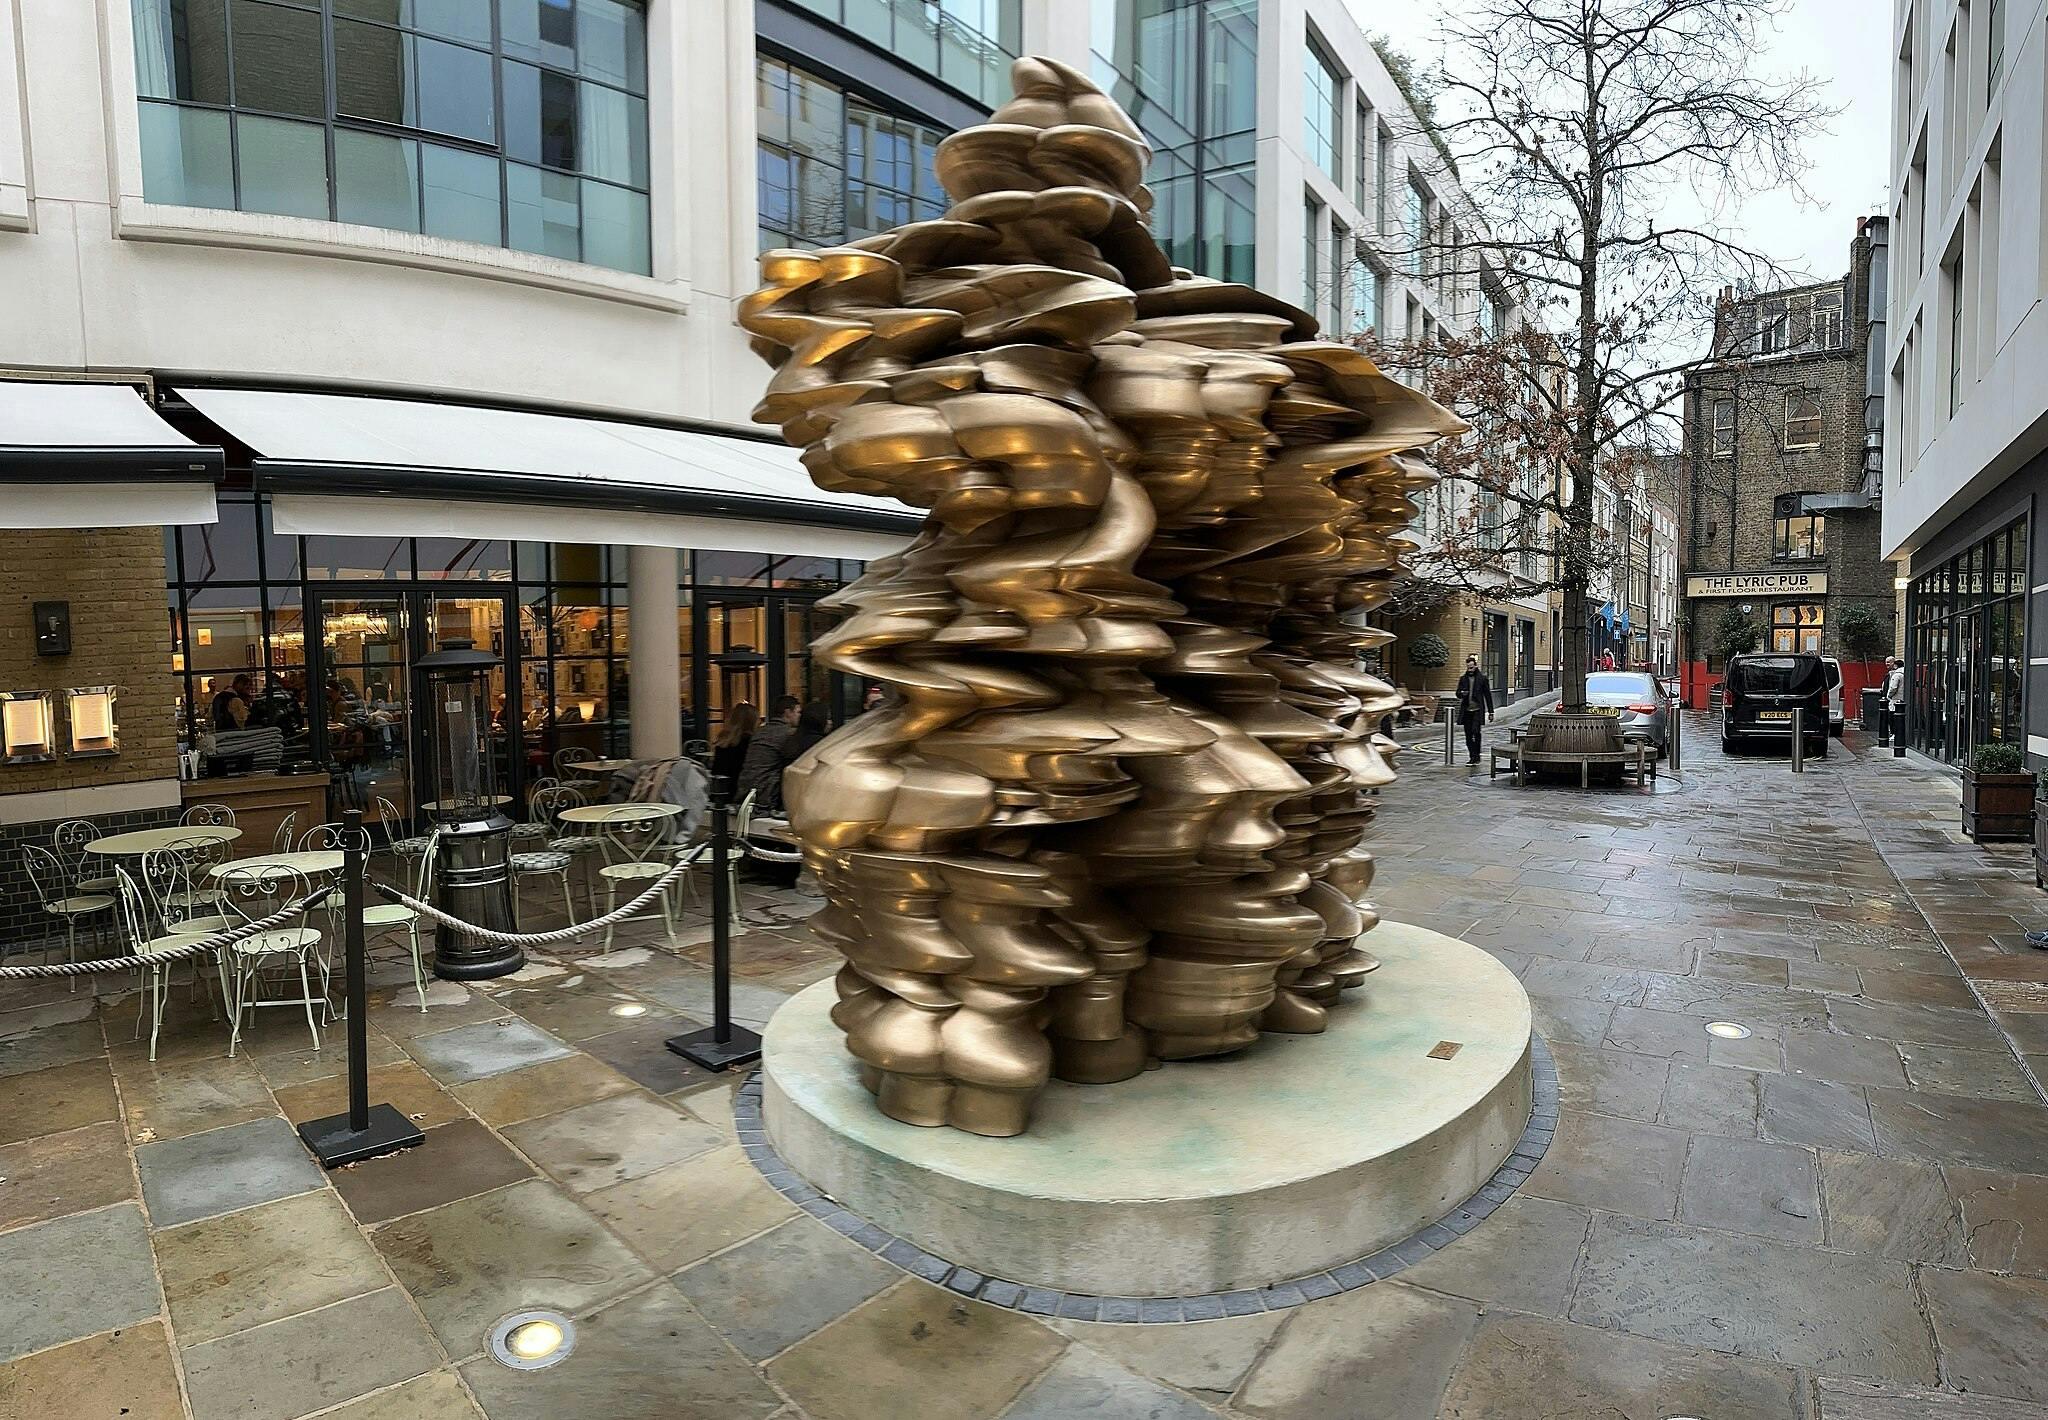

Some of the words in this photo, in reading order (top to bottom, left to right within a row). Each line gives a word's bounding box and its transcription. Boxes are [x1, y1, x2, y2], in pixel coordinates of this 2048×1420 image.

[1704, 577, 1732, 588] THE
[1736, 576, 1775, 588] LYRIC
[1779, 575, 1809, 586] PUB
[1758, 585, 1815, 593] RESTAURANT
